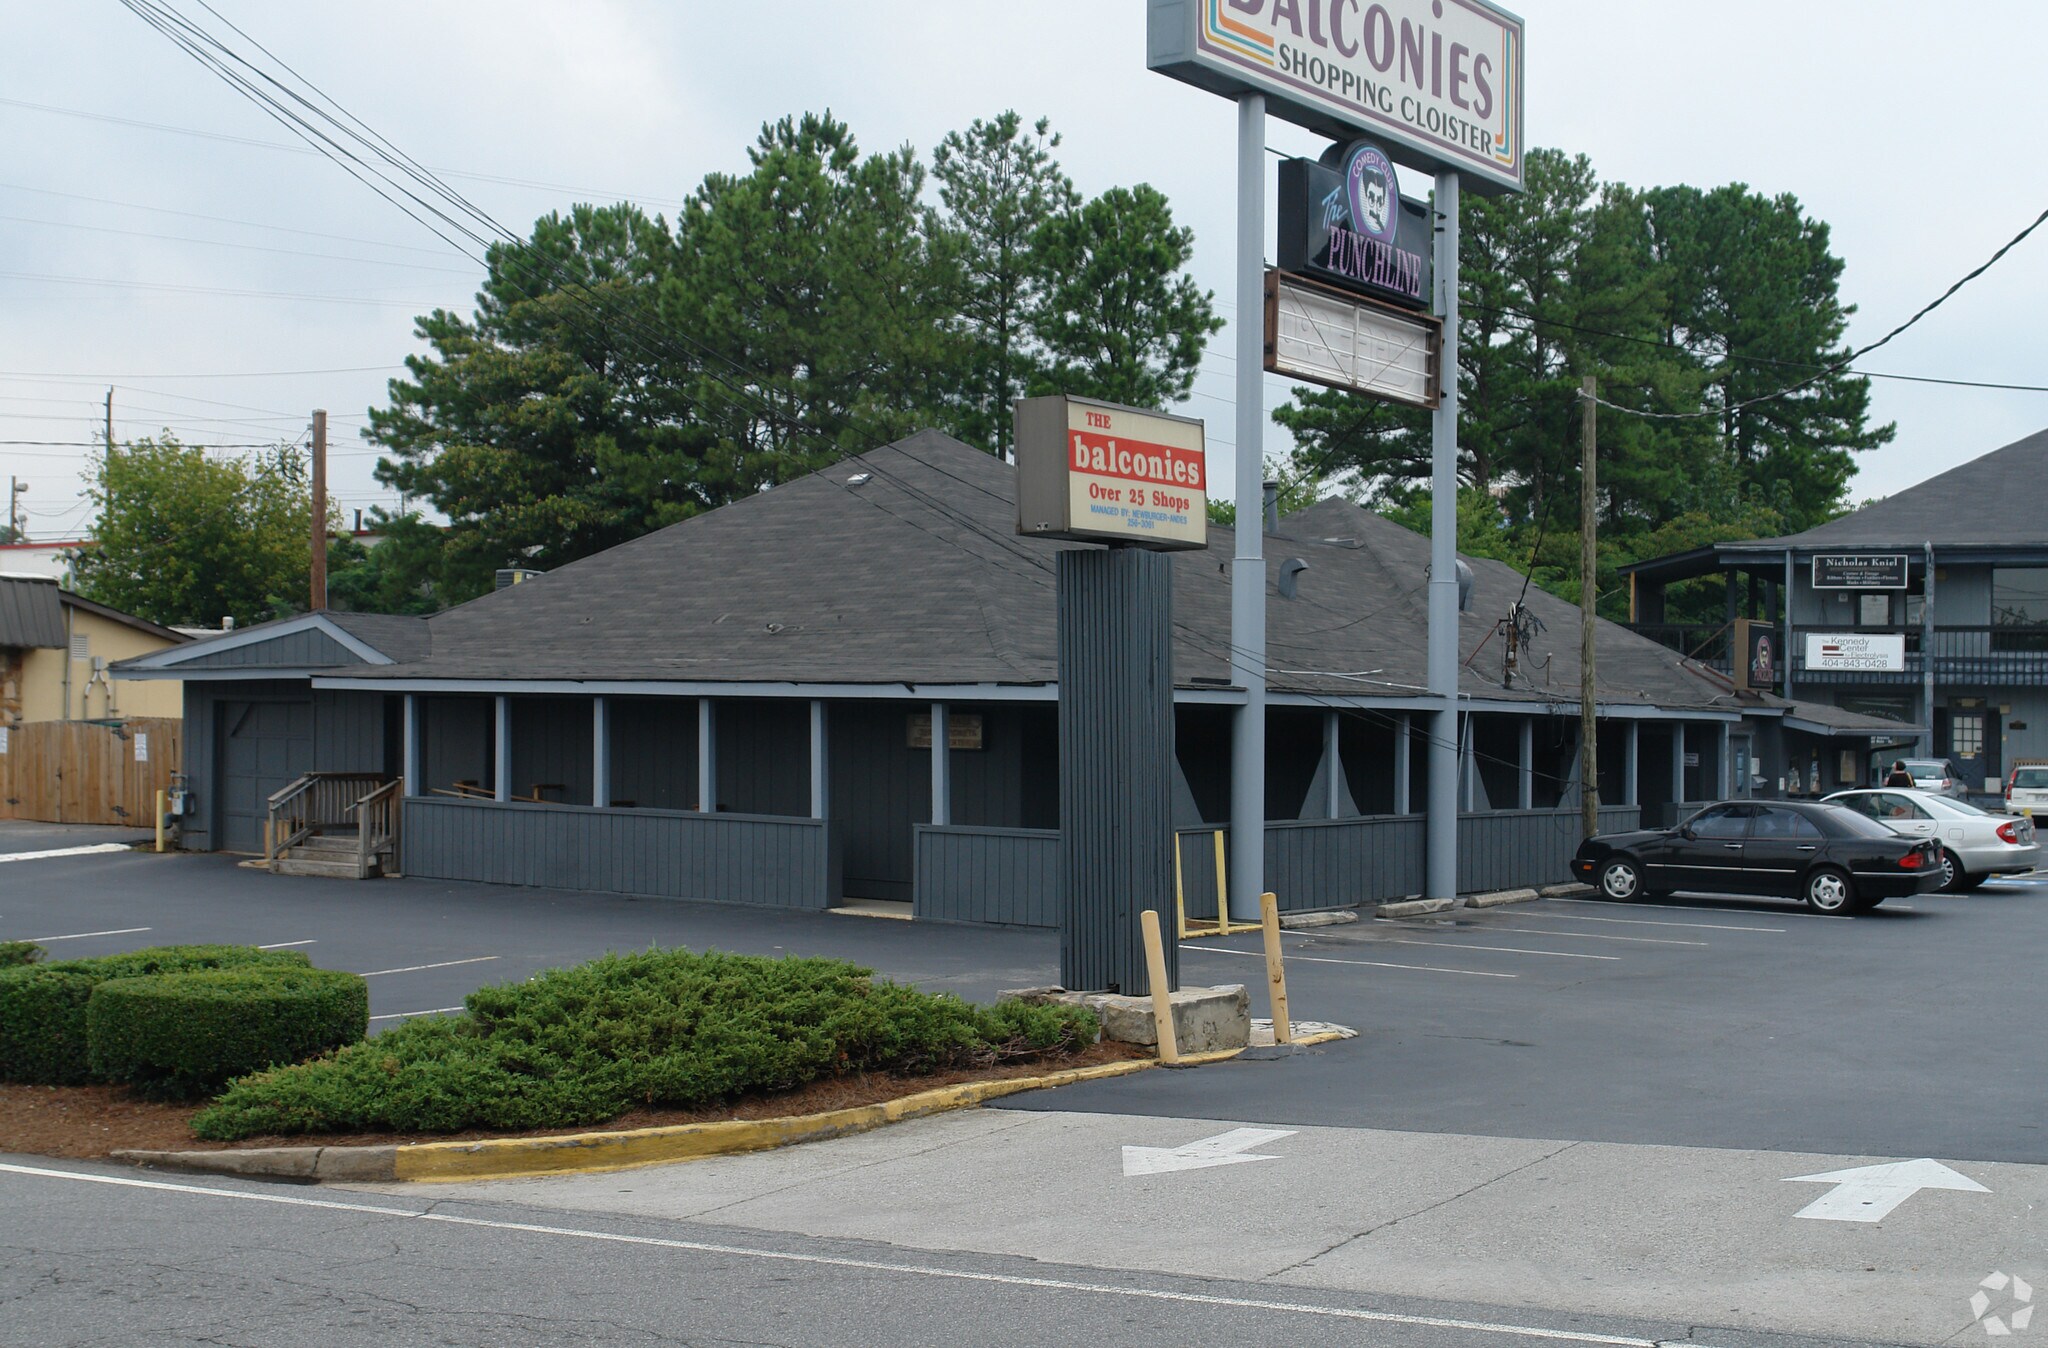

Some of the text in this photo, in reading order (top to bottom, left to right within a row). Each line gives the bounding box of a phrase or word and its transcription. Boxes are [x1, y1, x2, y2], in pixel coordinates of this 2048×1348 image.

[1278, 43, 1493, 156] SHOPPING CLOISTER
[1352, 152, 1394, 190] COMEDY CLUB
[1321, 185, 1348, 230] The
[1327, 225, 1422, 297] PUNCHLINE
[1085, 411, 1111, 429] THE
[1073, 435, 1200, 485] balconies
[1089, 482, 1190, 513] Over 25 Shops
[1090, 504, 1119, 516] MANAGED
[1121, 508, 1131, 518] BY:
[1826, 557, 1898, 567] Nicholas Kniel
[1830, 637, 1870, 646] Kennedy
[1840, 644, 1868, 652] Center
[1822, 659, 1888, 668] 404-843-0428
